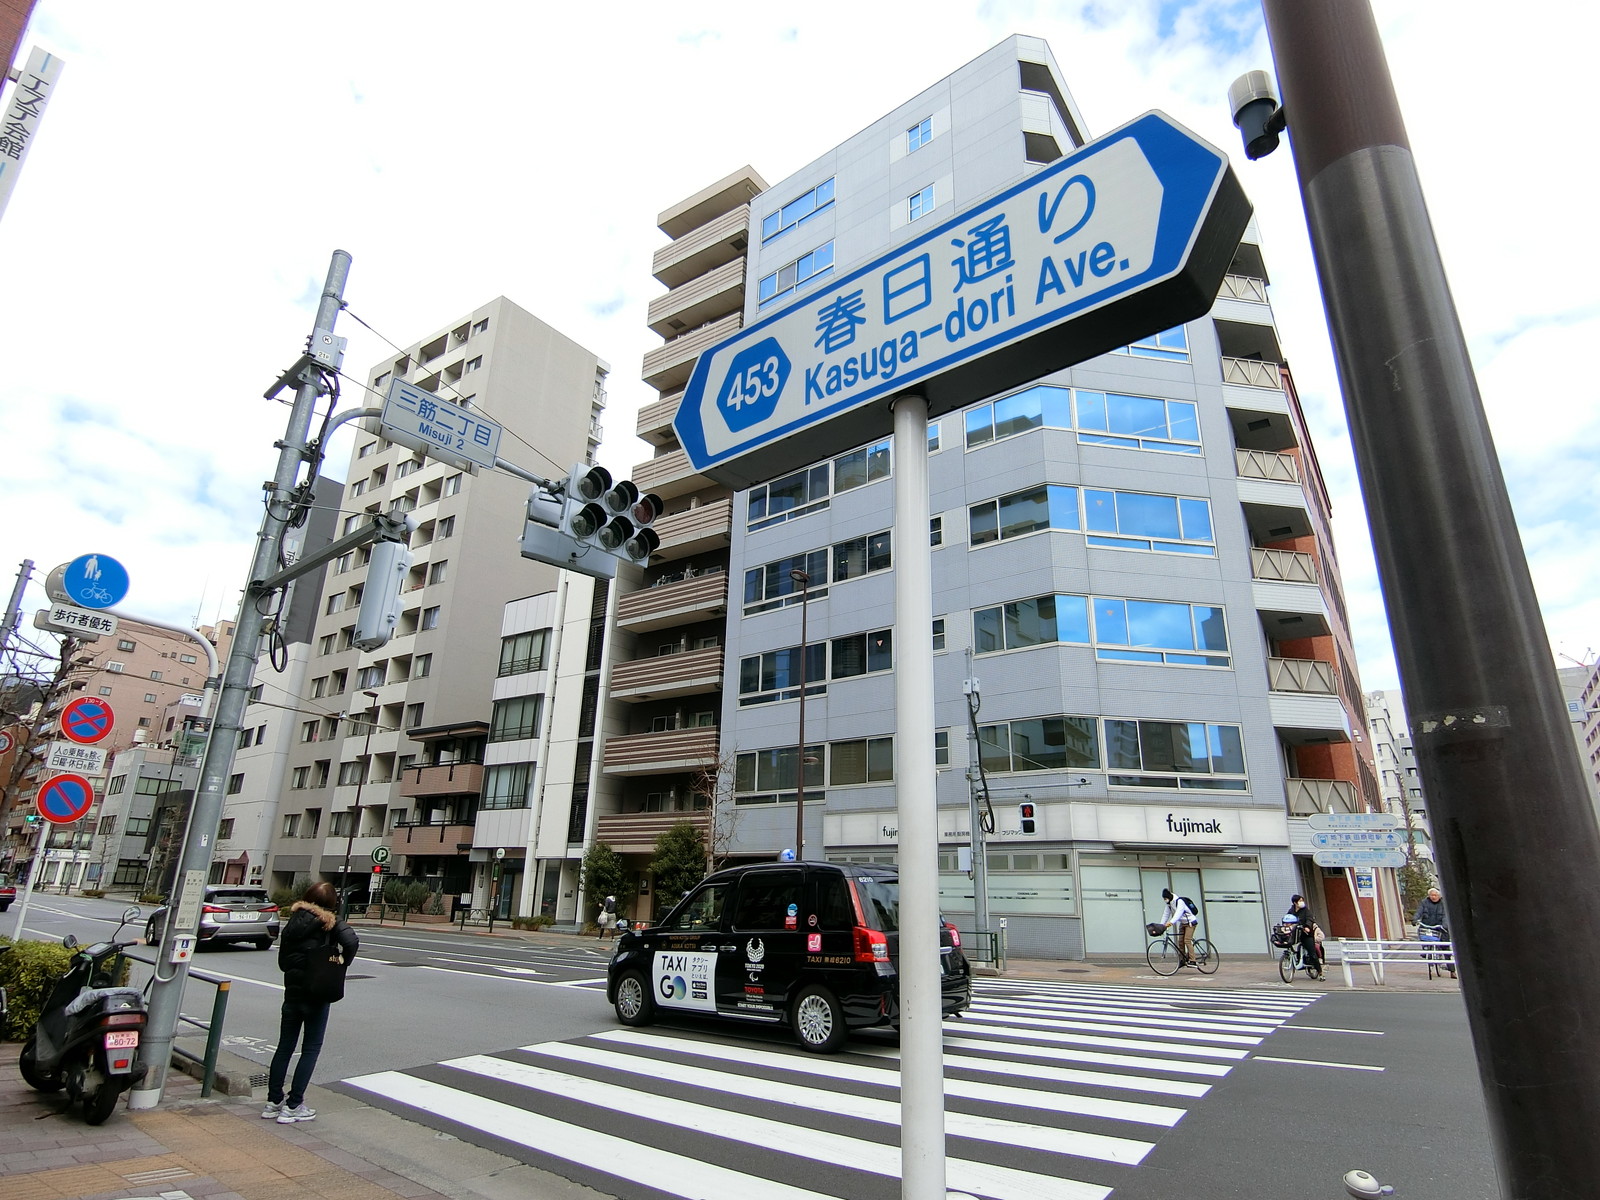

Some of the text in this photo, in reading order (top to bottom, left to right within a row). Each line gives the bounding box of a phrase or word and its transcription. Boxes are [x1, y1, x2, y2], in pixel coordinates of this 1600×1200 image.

[813, 174, 1097, 356] 春日通り
[804, 241, 1130, 406] Kasuga-dori Ave.
[726, 355, 780, 412] 453
[396, 388, 492, 447] 三筋二丁目
[418, 422, 465, 451] Misuji 2
[53, 608, 113, 632] 歩行者優先
[54, 745, 102, 761] 人の乗降を除く
[882, 825, 899, 839] fuji
[1166, 813, 1223, 837] fujimak
[377, 849, 387, 861] P
[661, 955, 688, 972] TAXI
[691, 964, 708, 973] アプリ
[807, 955, 823, 963] TAXI
[660, 974, 687, 1000] GO
[744, 986, 764, 994] TOYOTA
[114, 1037, 136, 1046] 80-72
